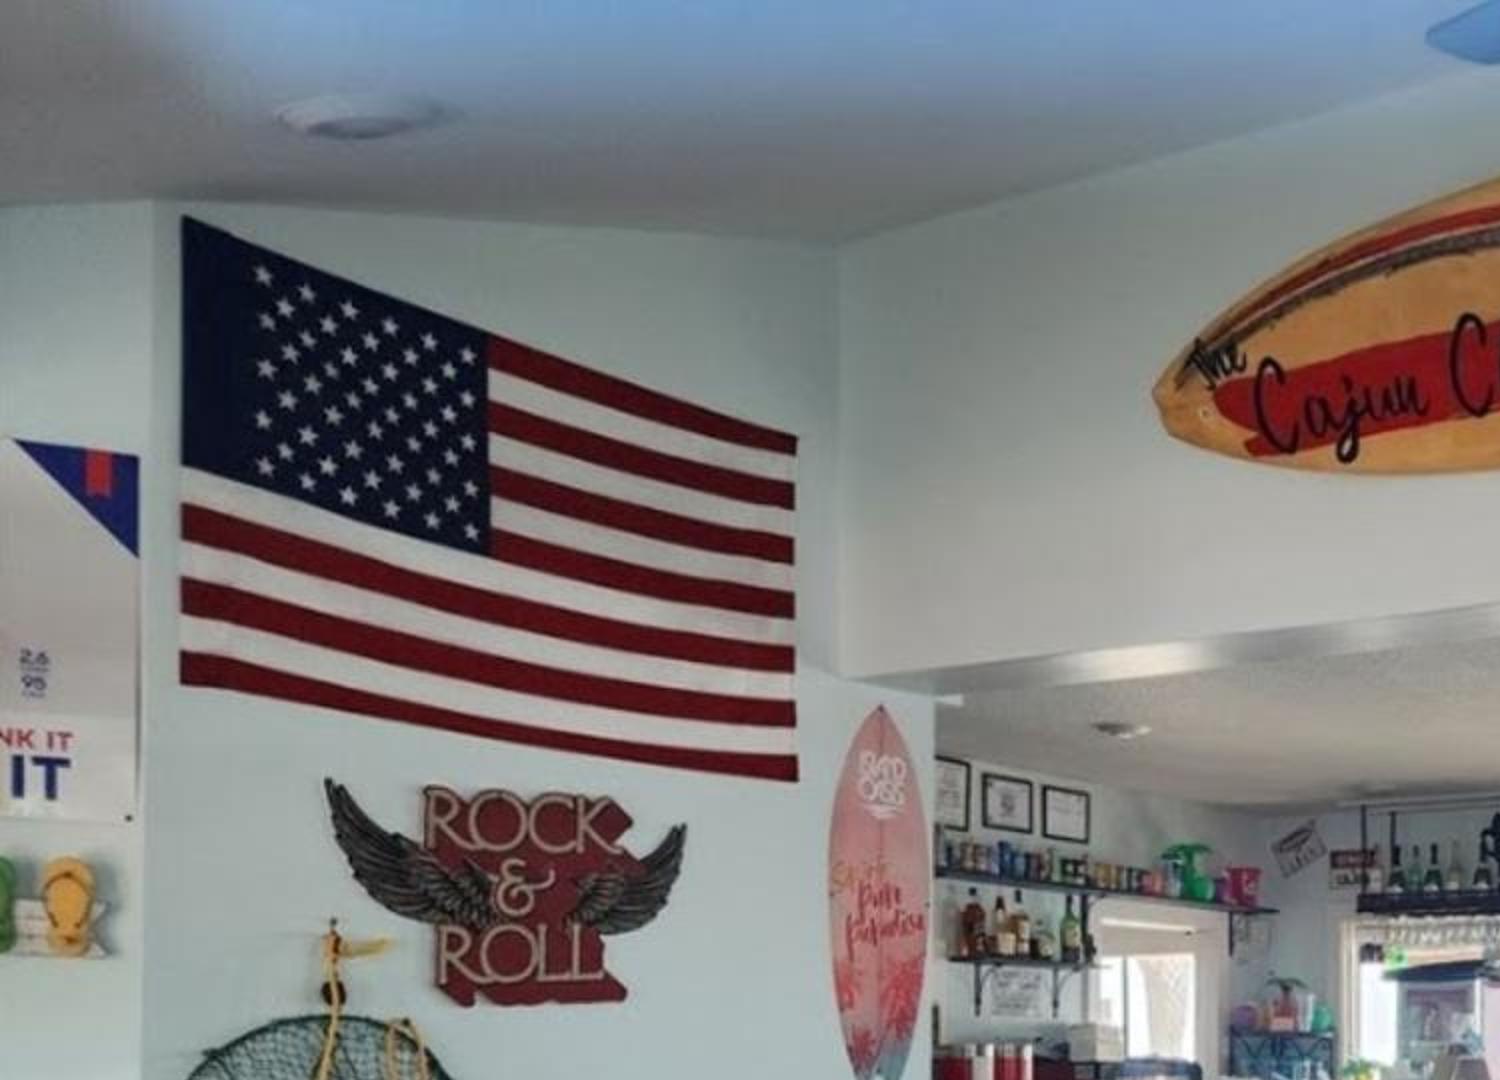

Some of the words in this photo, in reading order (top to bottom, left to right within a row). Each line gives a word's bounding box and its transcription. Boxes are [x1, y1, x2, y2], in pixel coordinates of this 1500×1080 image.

[1252, 356, 1428, 463] Cajun
[47, 731, 73, 751] IT
[11, 754, 71, 800] IT
[423, 786, 623, 856] ROCK
[490, 858, 555, 916] &
[438, 922, 606, 985] ROLL
